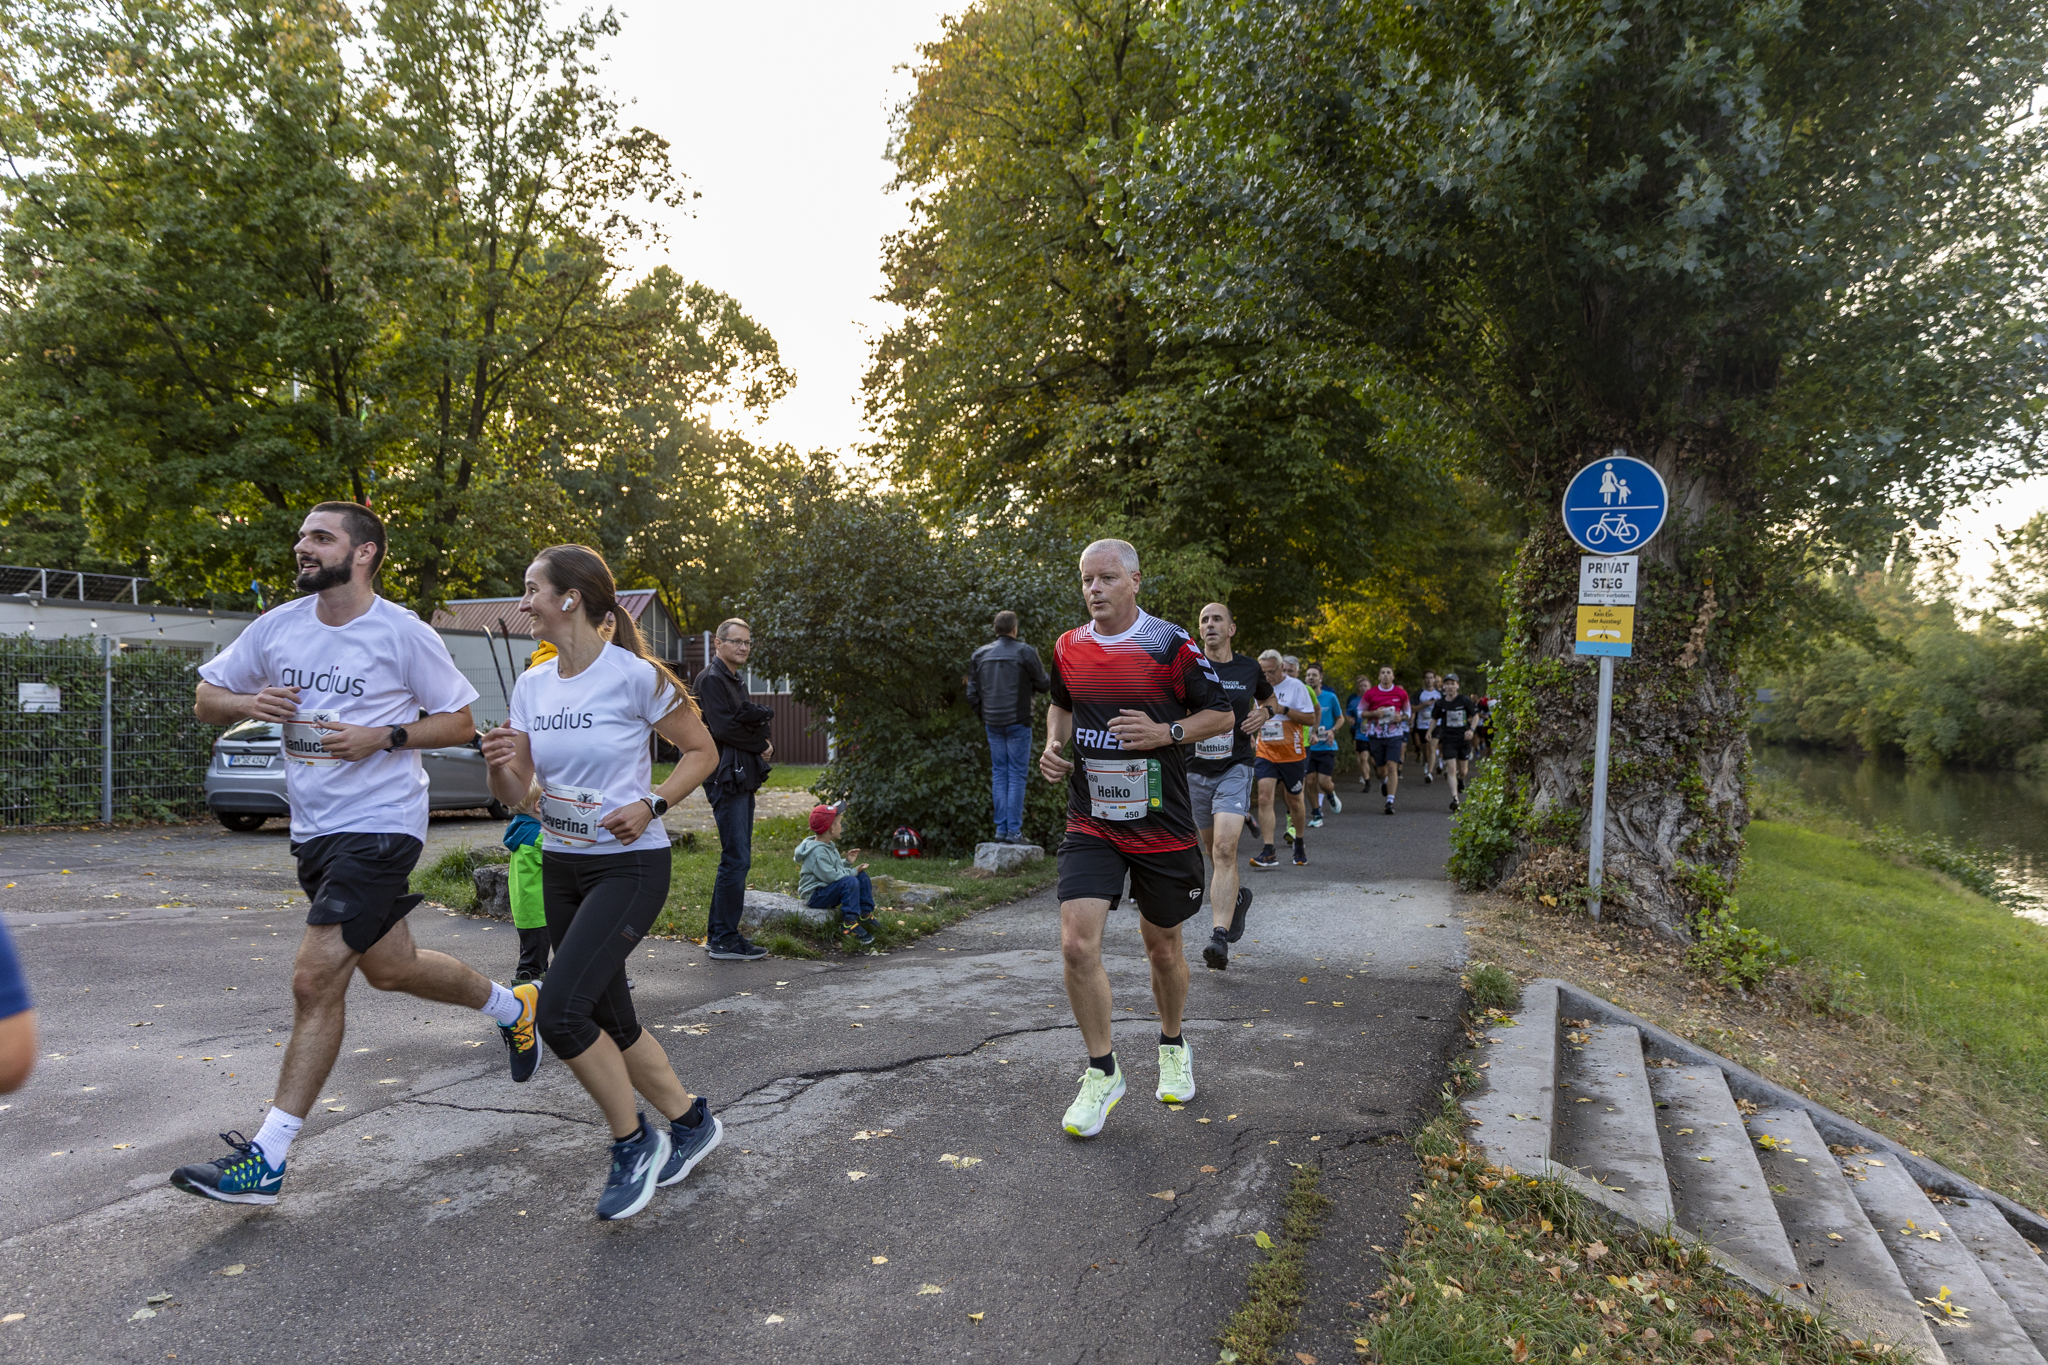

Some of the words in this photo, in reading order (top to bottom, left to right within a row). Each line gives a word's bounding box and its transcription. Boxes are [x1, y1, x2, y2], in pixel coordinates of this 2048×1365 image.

[1588, 562, 1629, 574] PRIVAT
[1592, 577, 1623, 589] STEG
[282, 665, 366, 697] audius
[533, 706, 593, 732] audius
[1197, 743, 1229, 752] Matthias
[1097, 785, 1131, 798] Heiko
[1124, 811, 1139, 819] 450
